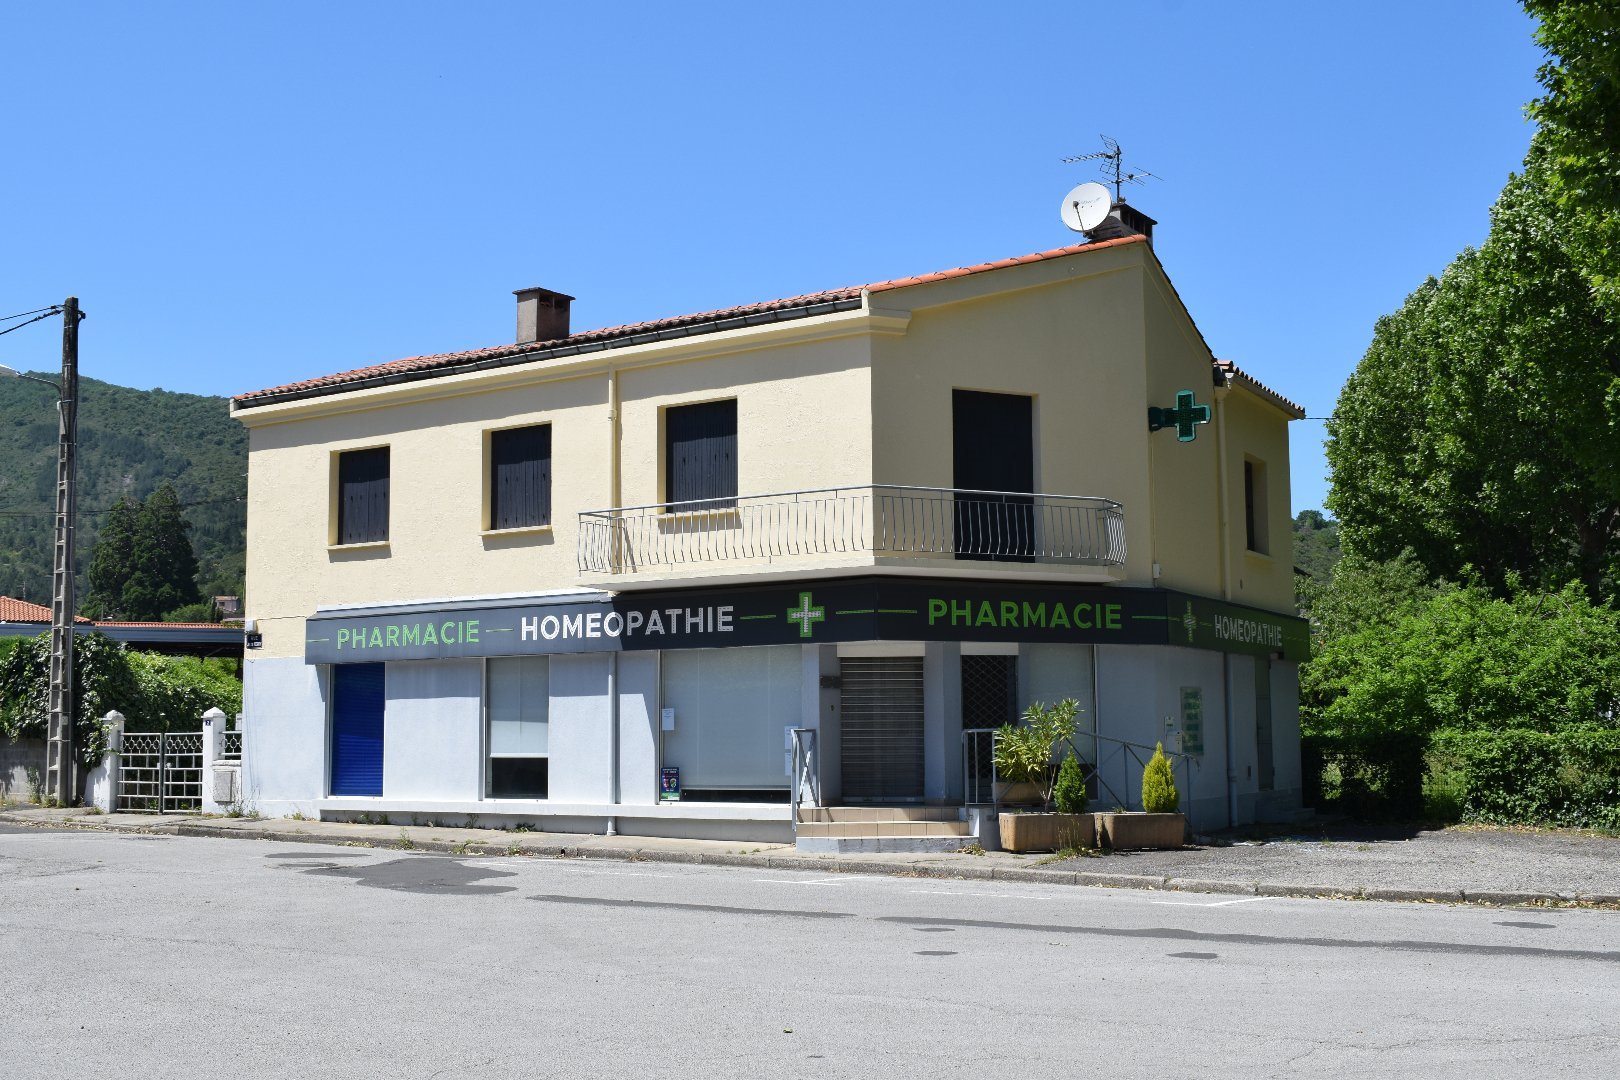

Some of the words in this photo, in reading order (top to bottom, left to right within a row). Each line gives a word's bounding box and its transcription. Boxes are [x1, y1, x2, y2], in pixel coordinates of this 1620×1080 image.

[337, 619, 480, 649] PHARMACIE
[521, 605, 734, 641] HOMEOPATHIE
[928, 598, 1122, 630] PHARMACIE
[1214, 614, 1282, 647] HOMEOPATHIE
